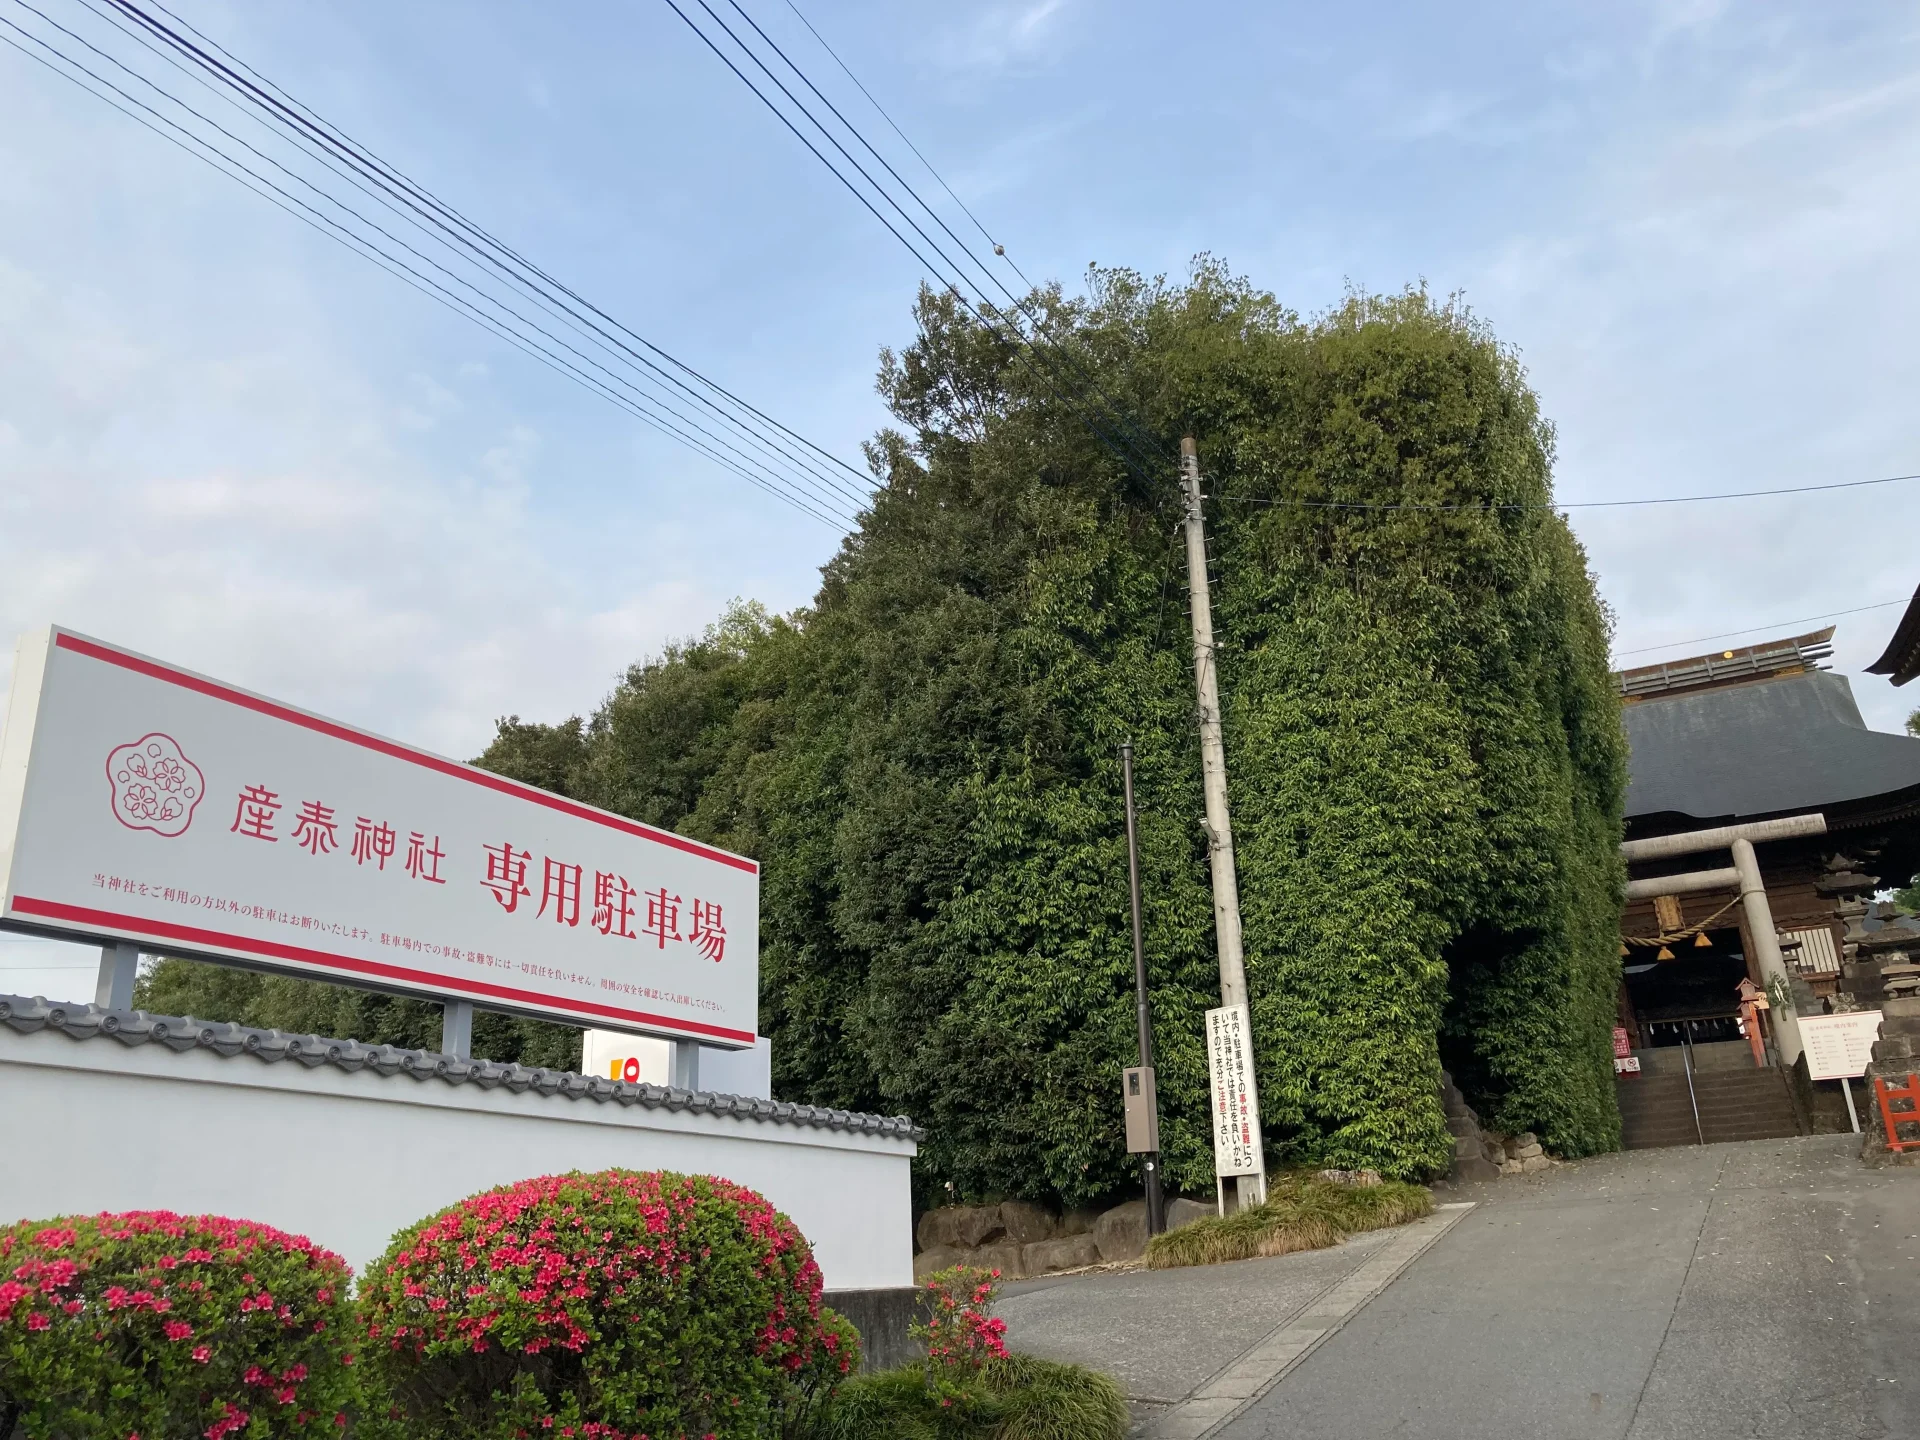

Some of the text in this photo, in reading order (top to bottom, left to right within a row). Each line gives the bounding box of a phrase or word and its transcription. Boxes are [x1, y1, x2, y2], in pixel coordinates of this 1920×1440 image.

[230, 784, 727, 963] 産泰神社 専用駐車場
